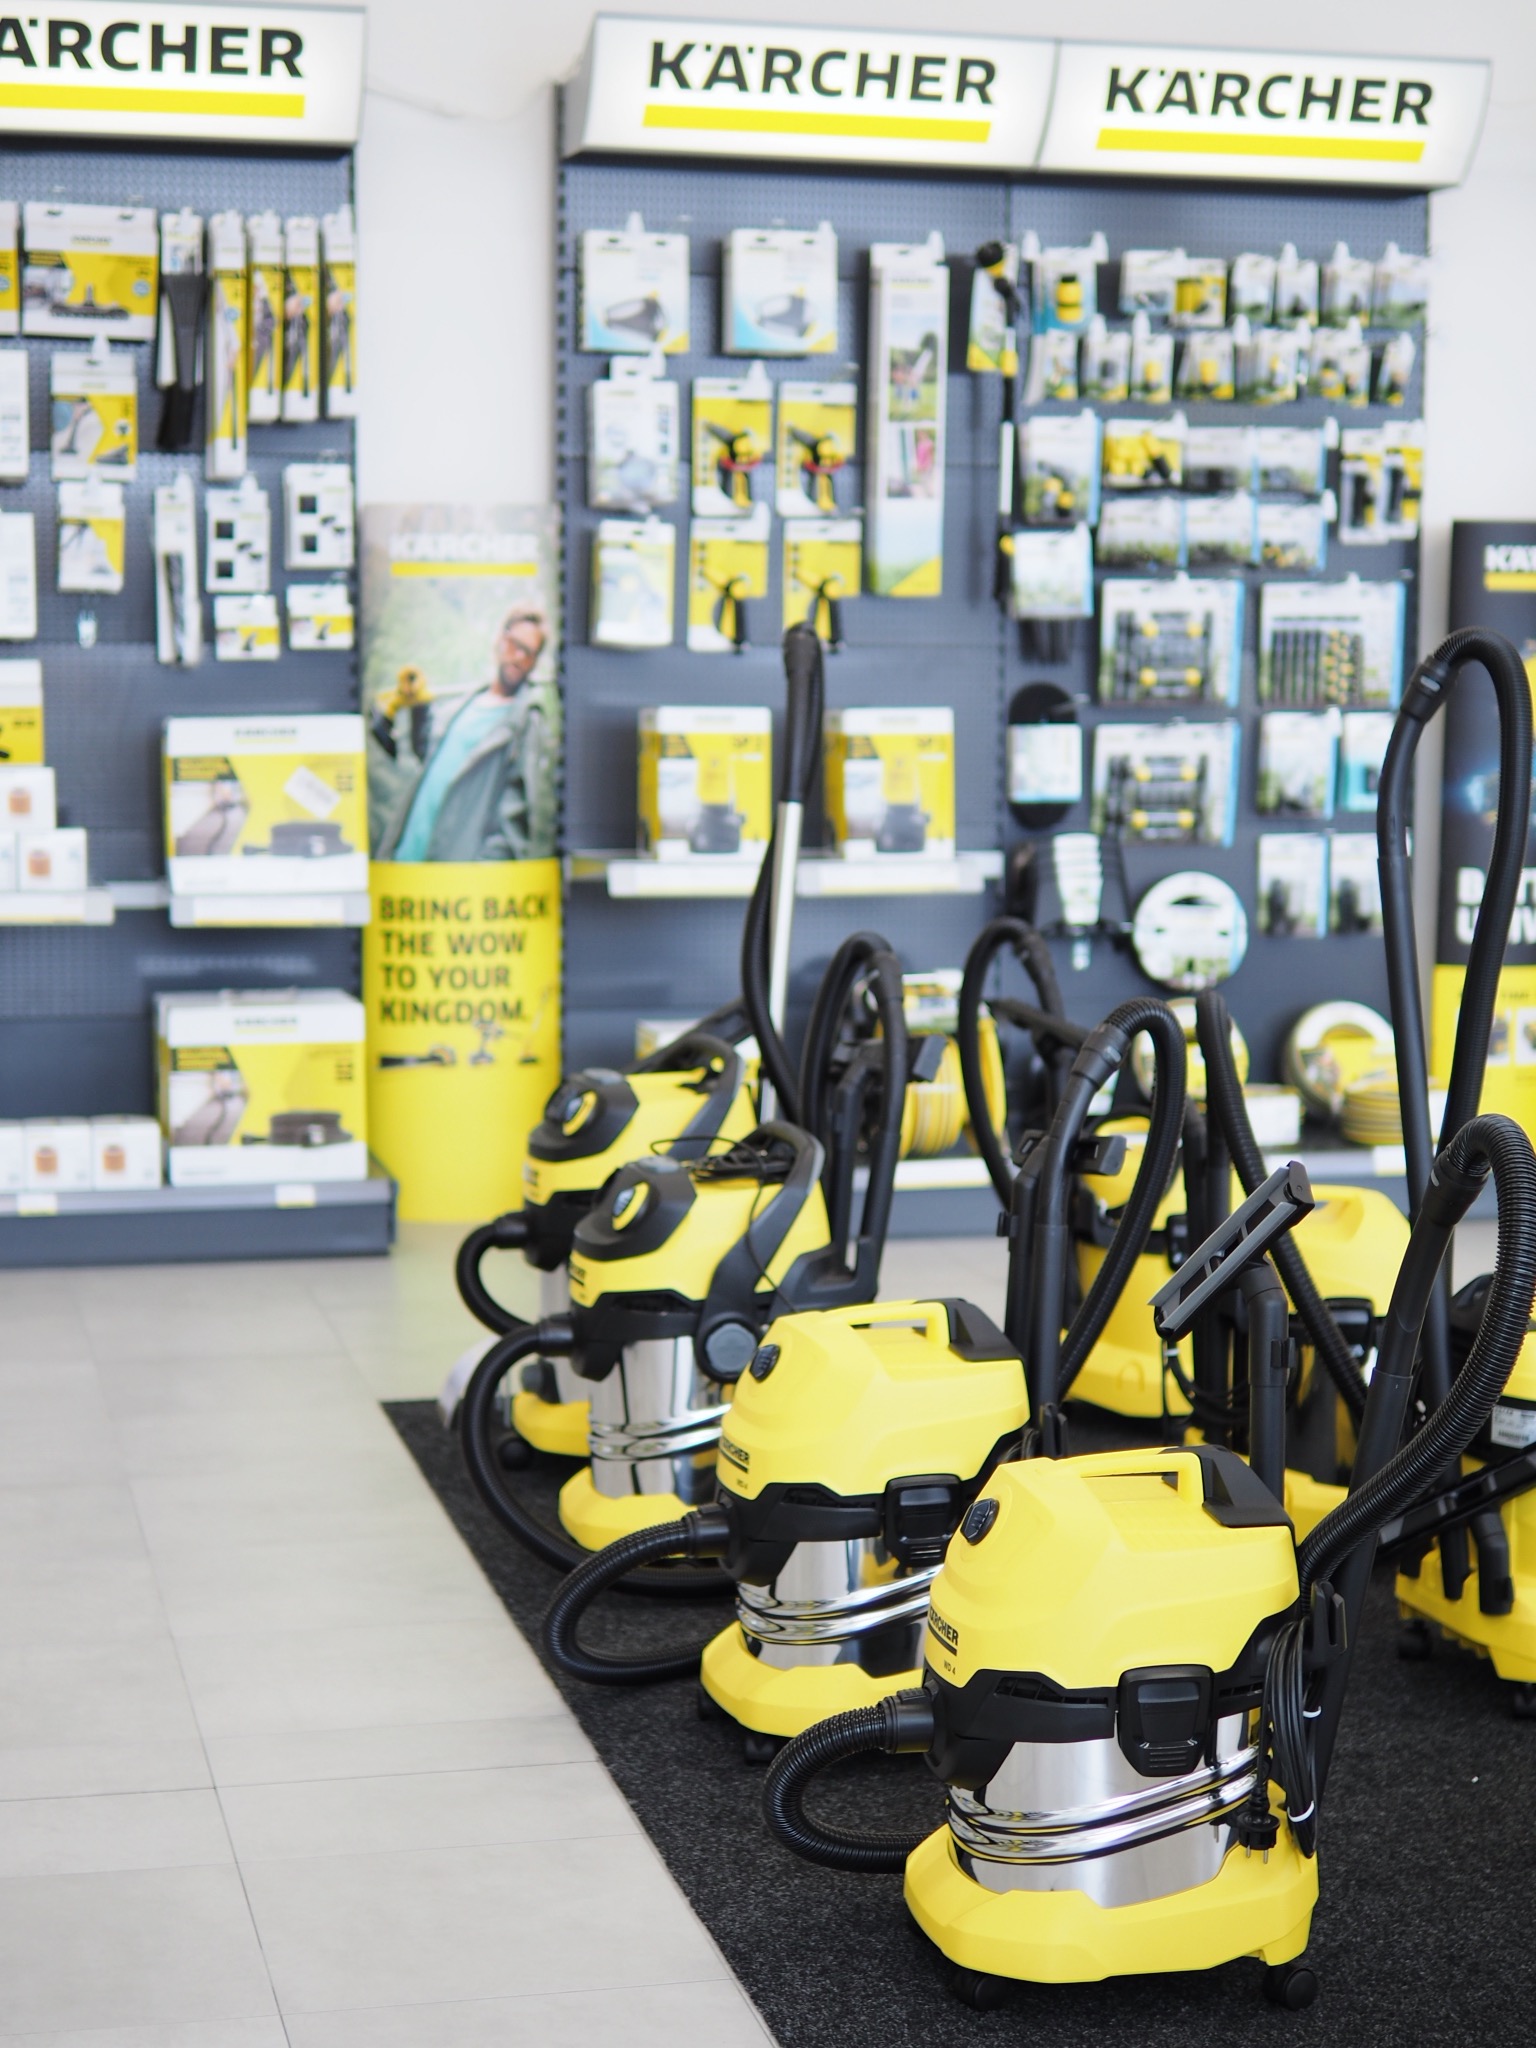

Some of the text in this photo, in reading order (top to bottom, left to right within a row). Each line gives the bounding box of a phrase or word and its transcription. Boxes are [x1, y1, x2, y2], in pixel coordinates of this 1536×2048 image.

[650, 41, 996, 104] KÄRCHER
[1106, 68, 1433, 125] KÄRCHER
[380, 894, 550, 921] BRING BACK
[381, 931, 526, 956] THE WOW
[381, 964, 511, 990] TO YOUR
